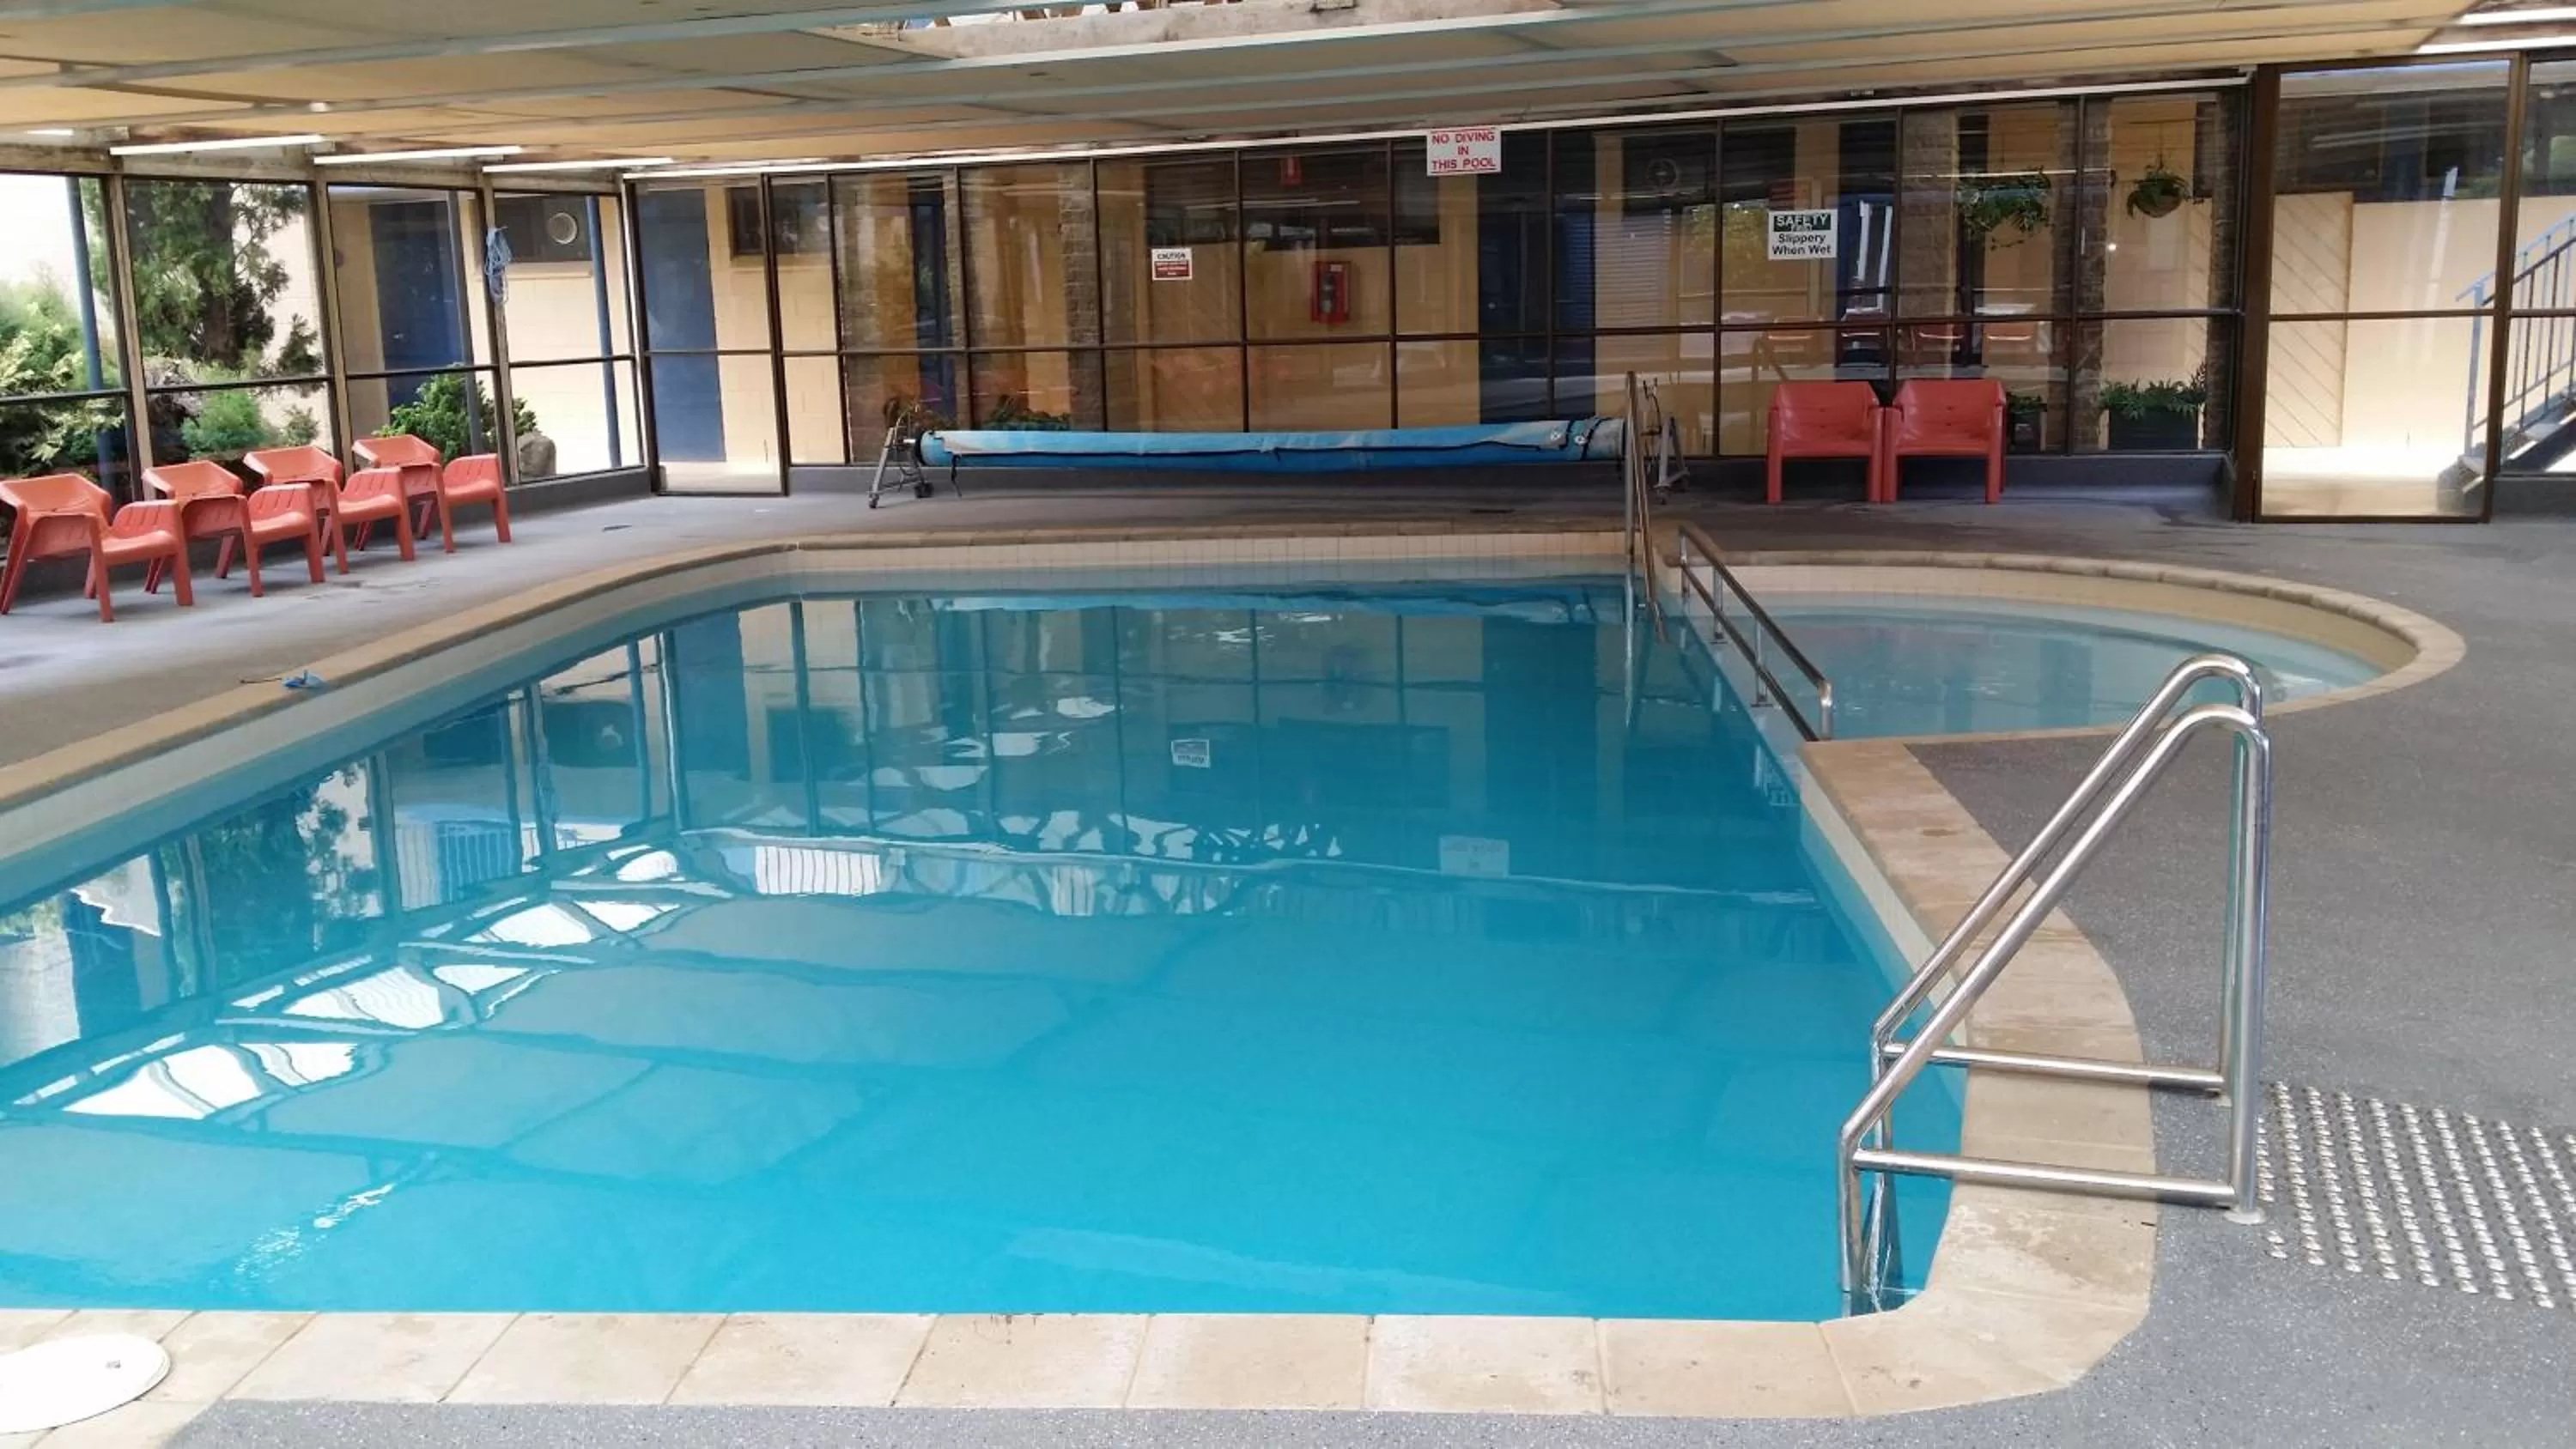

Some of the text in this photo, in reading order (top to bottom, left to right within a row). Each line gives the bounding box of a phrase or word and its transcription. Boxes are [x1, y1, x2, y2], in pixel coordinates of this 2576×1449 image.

[1431, 130, 1495, 144] NO DIVING
[1457, 145, 1469, 155] IN
[1431, 157, 1497, 170] THIS POOL
[1776, 212, 1829, 227] SAFETY
[1778, 233, 1826, 245] Slippery
[1771, 244, 1832, 255] When Wet
